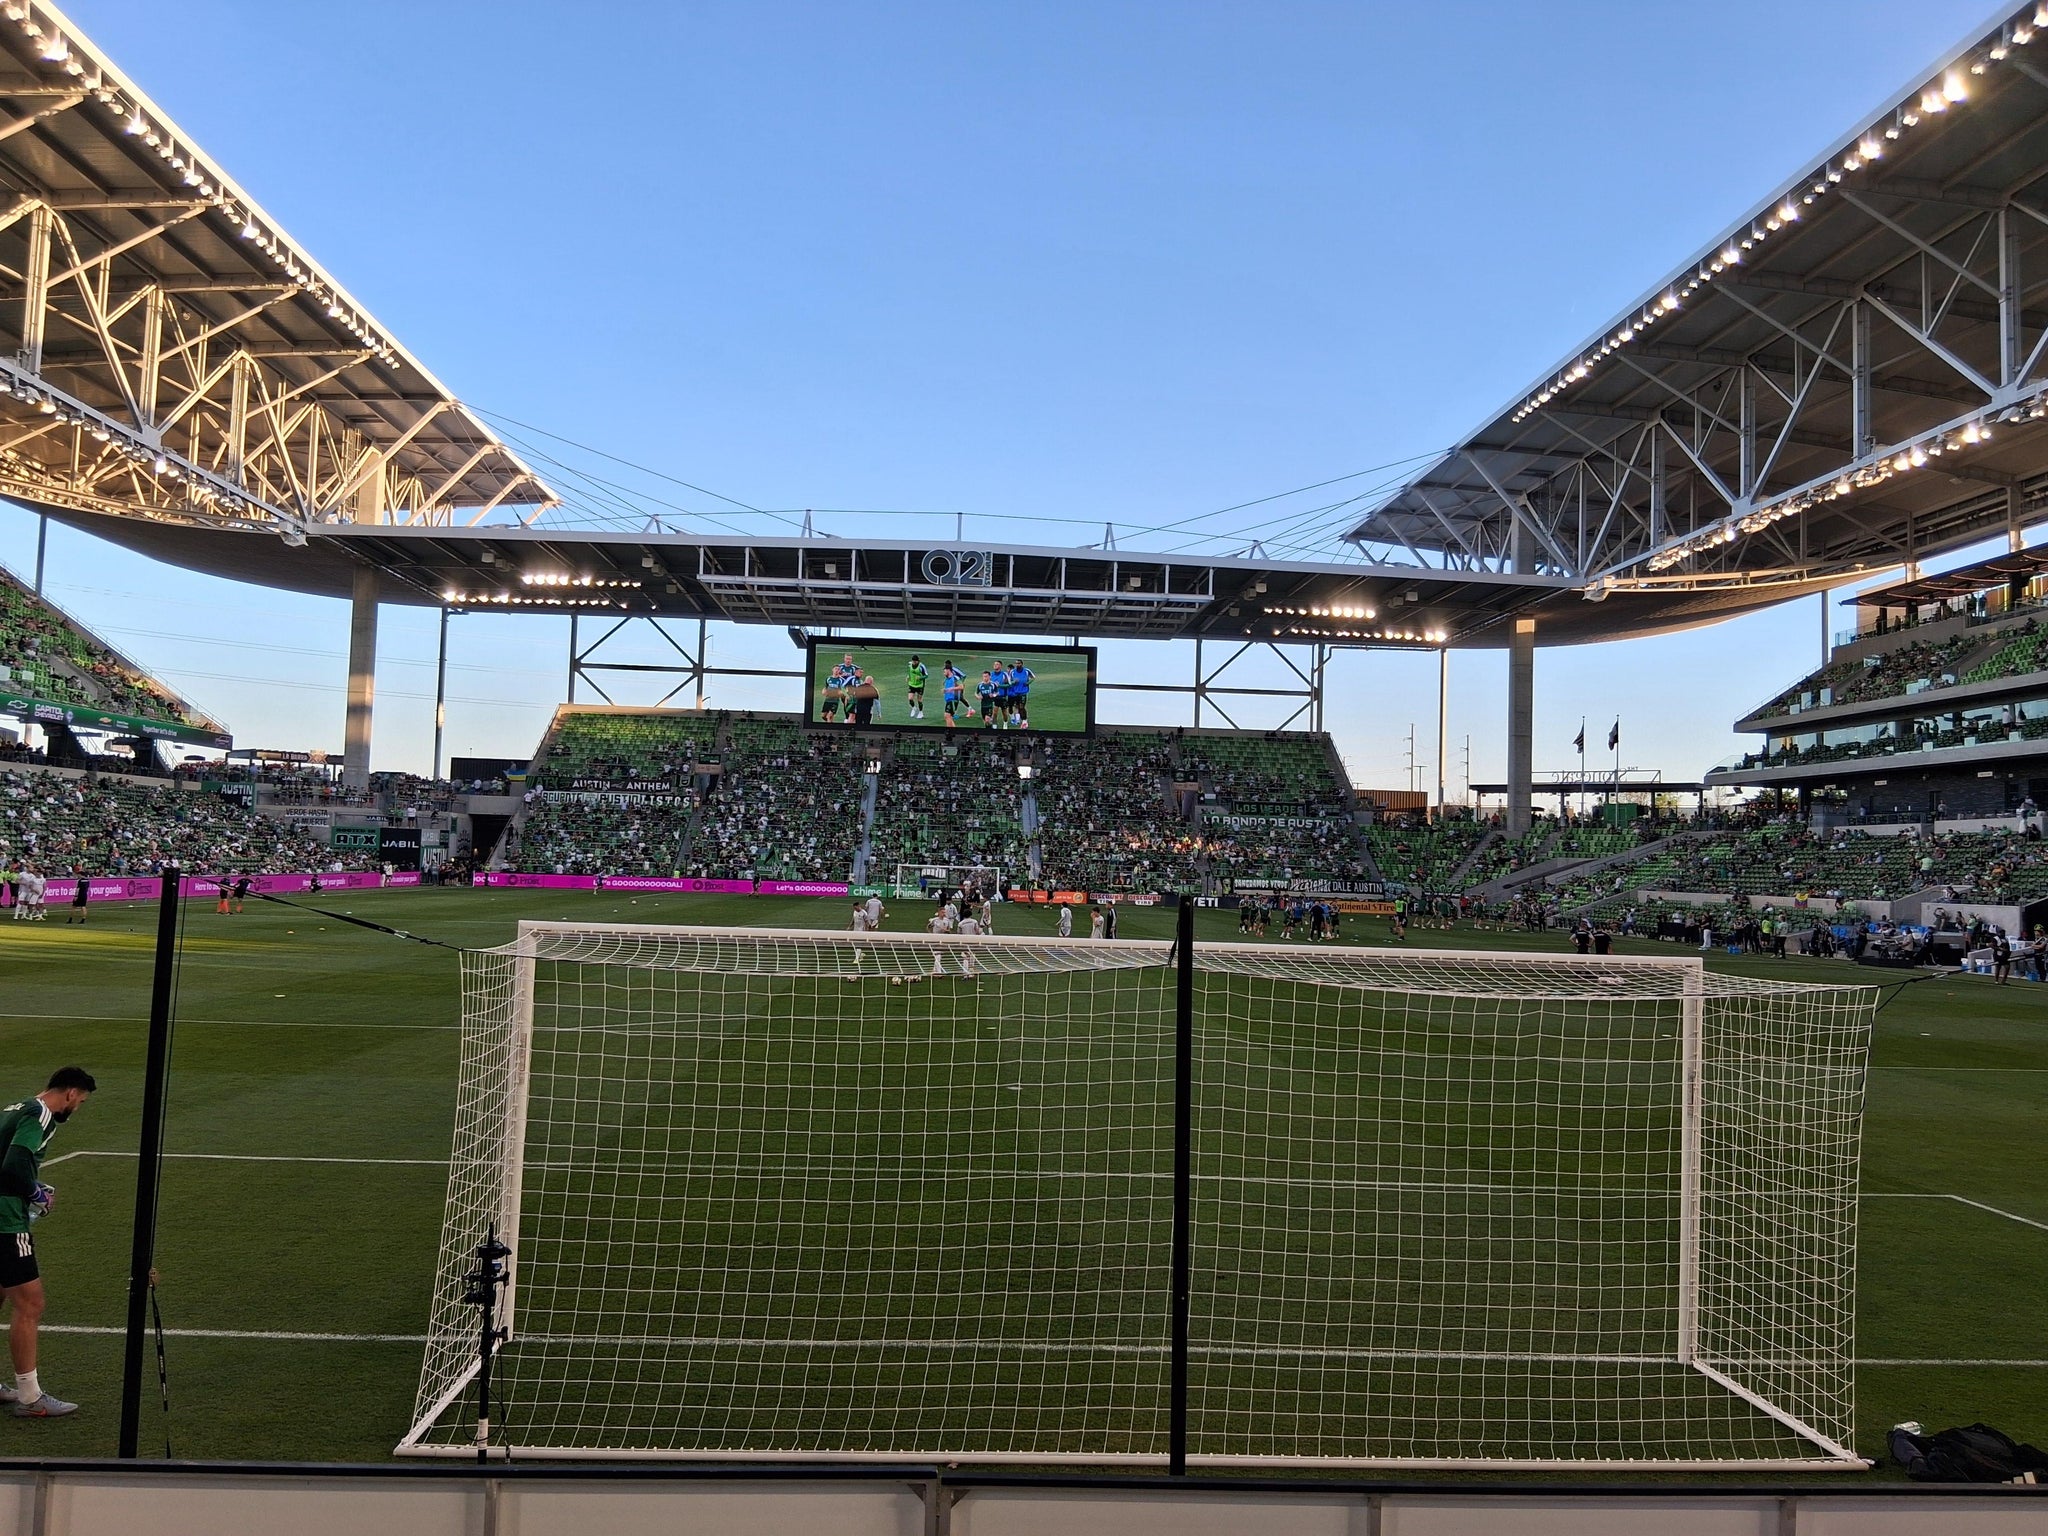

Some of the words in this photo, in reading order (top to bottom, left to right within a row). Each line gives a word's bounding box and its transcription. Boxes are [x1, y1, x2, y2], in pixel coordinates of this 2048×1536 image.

[921, 548, 984, 586] Q2
[34, 704, 64, 715] CAPITOL
[221, 785, 253, 795] AUSTIN
[572, 780, 611, 790] AUSTIN
[626, 782, 670, 791] ANTHEM
[241, 796, 252, 806] FC
[1236, 804, 1257, 812] LOS
[1204, 815, 1220, 825] LA
[1270, 817, 1286, 827] DE
[335, 834, 377, 846] ATX
[382, 840, 420, 849] JABIL
[44, 887, 60, 897] Here
[60, 887, 68, 896] to
[90, 887, 105, 897] your
[105, 884, 122, 896] goals
[853, 887, 882, 897] chime
[1332, 882, 1351, 892] DALE
[1354, 882, 1383, 893] AUSTIN
[1334, 902, 1370, 911] ntinental
